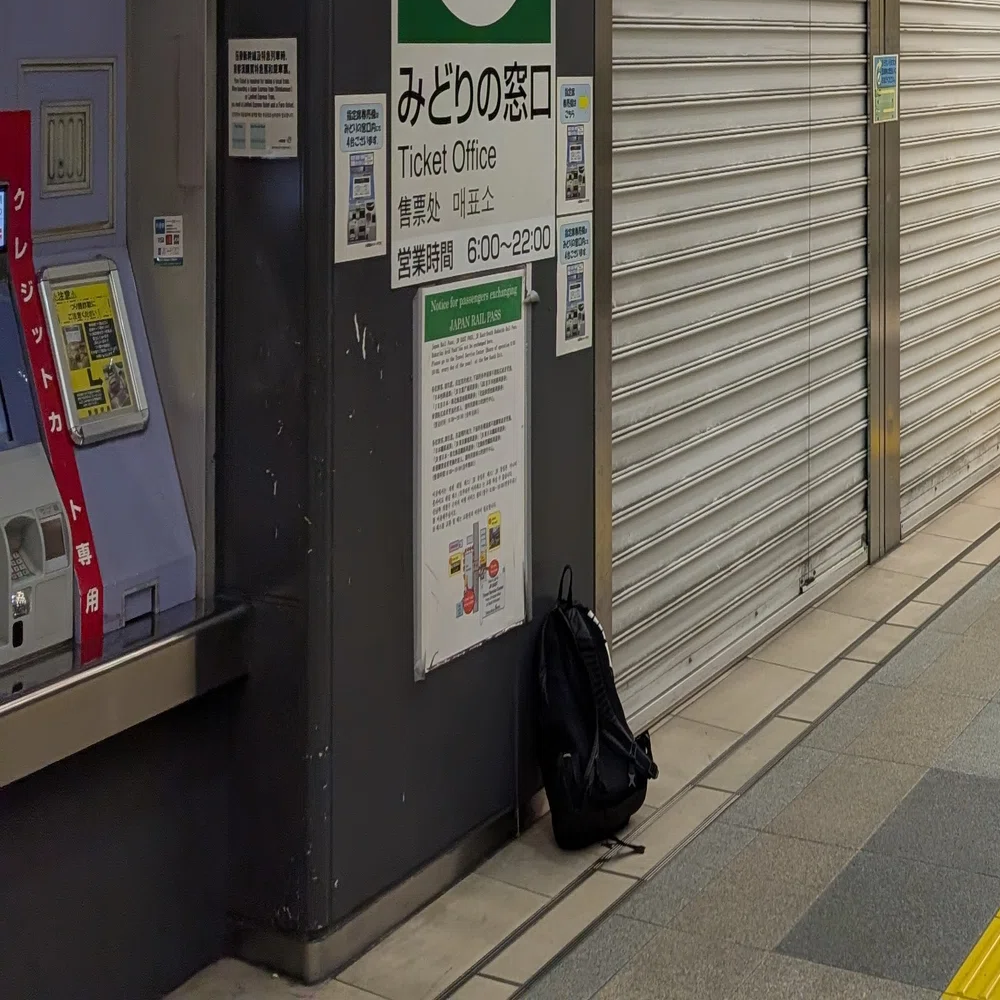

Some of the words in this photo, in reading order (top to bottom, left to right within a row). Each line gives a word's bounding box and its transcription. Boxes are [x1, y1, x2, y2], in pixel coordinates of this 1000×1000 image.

[398, 61, 551, 126] みどりの窓口
[398, 144, 447, 178] Ticket
[453, 139, 496, 173] Office
[398, 192, 440, 229] 售票处
[453, 185, 494, 219] 매표소
[398, 240, 453, 280] 営業時間
[431, 299, 449, 312] Notice
[450, 296, 458, 308] for
[459, 292, 489, 308] passengers
[490, 286, 518, 299] exchanging
[449, 315, 470, 332] JAPAN
[471, 312, 487, 326] RAIL
[487, 309, 502, 323] PASS
